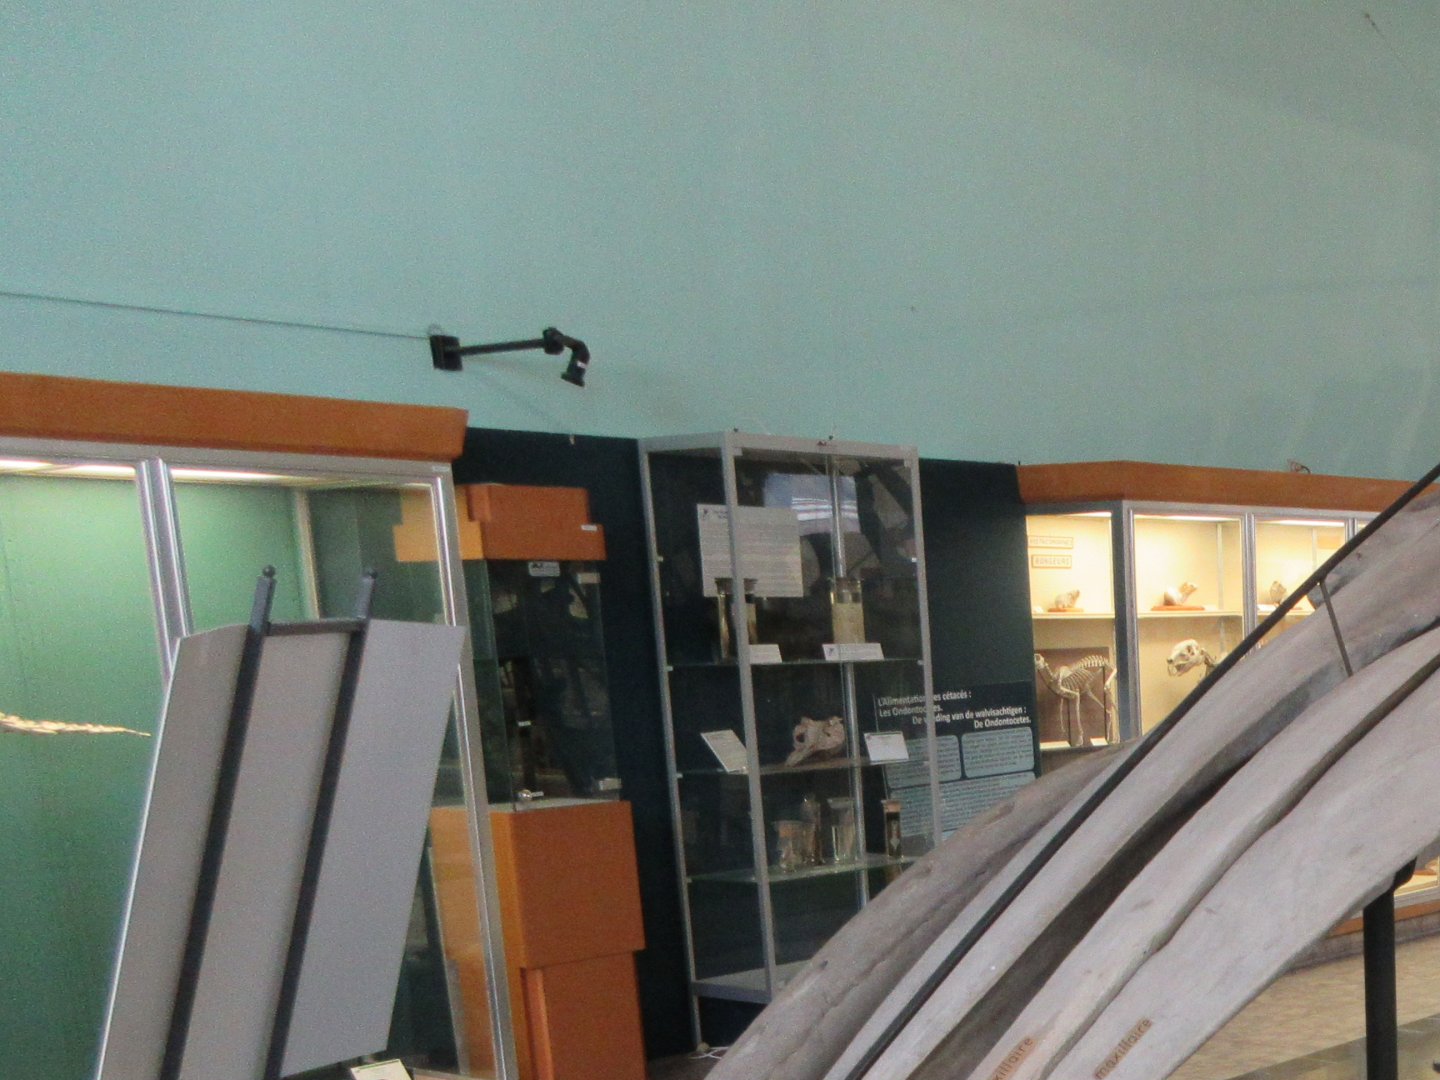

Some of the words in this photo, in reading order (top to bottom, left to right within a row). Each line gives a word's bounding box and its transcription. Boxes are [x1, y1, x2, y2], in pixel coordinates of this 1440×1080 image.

[892, 704, 943, 716] Ondontoces.
[951, 712, 964, 721] van
[965, 710, 974, 719] de
[974, 720, 984, 729] De
[1095, 1018, 1152, 1080] maxillaire
